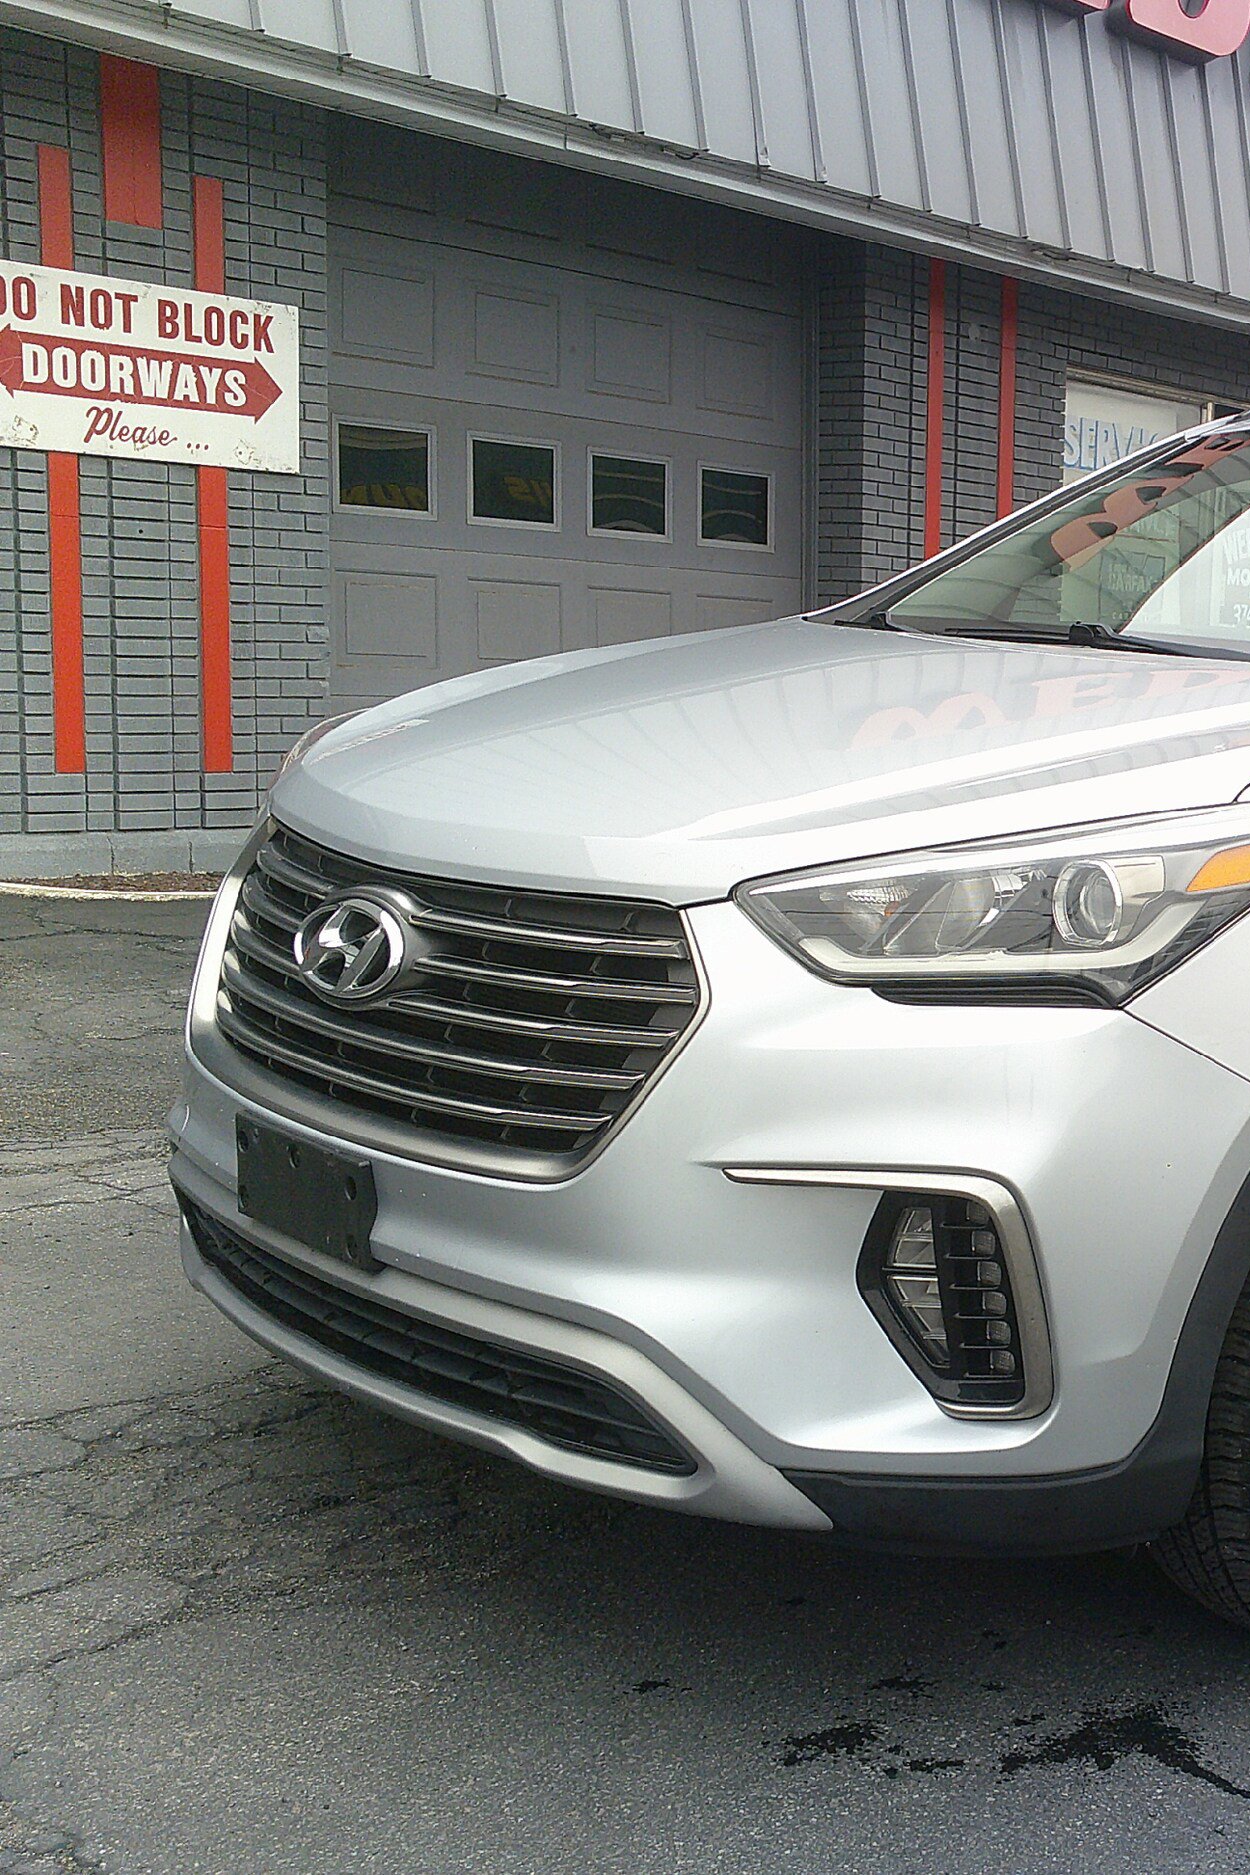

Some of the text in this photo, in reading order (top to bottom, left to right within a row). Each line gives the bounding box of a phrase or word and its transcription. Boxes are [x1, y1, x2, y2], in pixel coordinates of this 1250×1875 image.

[0, 275, 275, 354] O NOT BLOCK
[21, 341, 248, 408] DOORWAYS
[83, 404, 178, 447] Please
